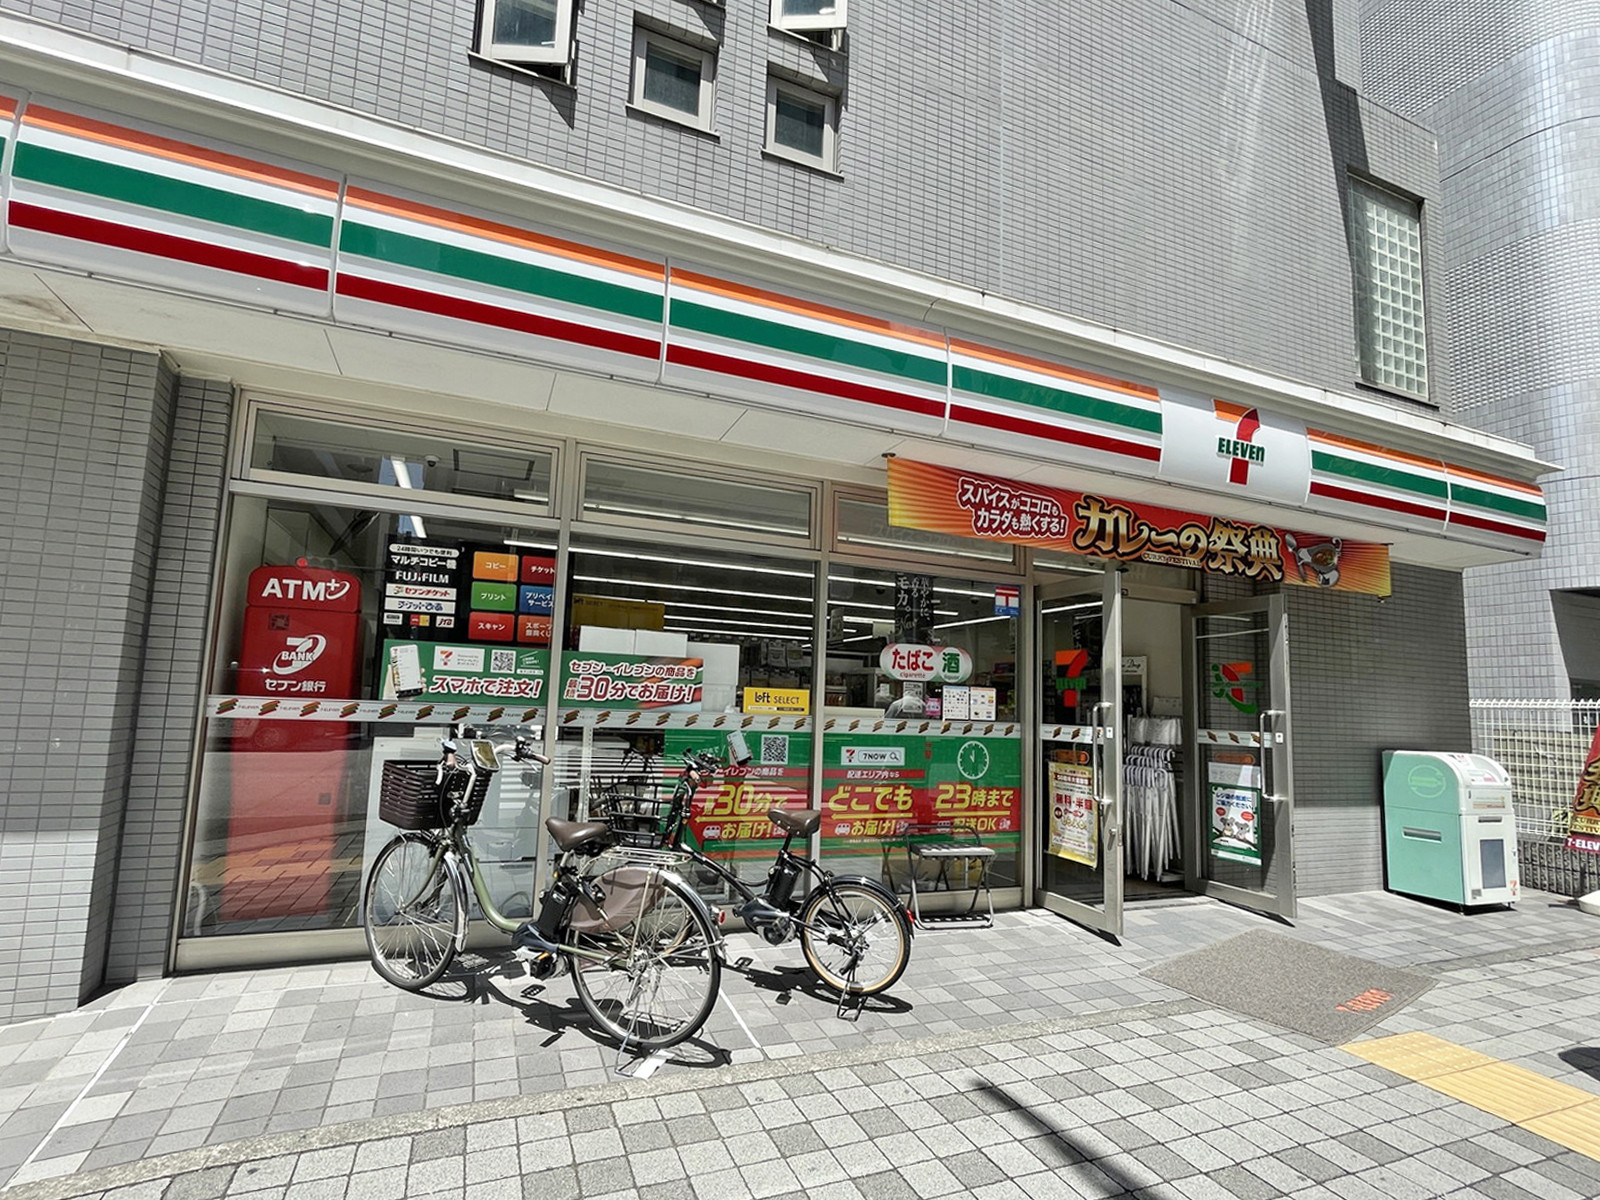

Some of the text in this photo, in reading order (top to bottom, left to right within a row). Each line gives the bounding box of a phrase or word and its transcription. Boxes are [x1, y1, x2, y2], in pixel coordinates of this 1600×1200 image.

[962, 483, 1059, 516] スパイスがココロも
[976, 507, 1065, 533] カラダも熱くする!
[1075, 496, 1284, 582] カレーの祭典
[1168, 557, 1202, 568] FESTIVAL
[480, 593, 506, 601] プリント
[477, 622, 506, 631] スキャン
[281, 651, 317, 661] BANK
[891, 648, 935, 672] たばこ
[942, 651, 960, 674] 酒
[264, 678, 326, 692] セブン銀行
[430, 677, 543, 699] スマホで注文!
[773, 695, 800, 705] SELECT
[828, 785, 913, 811] どこでも
[935, 784, 1014, 809] 23時まで
